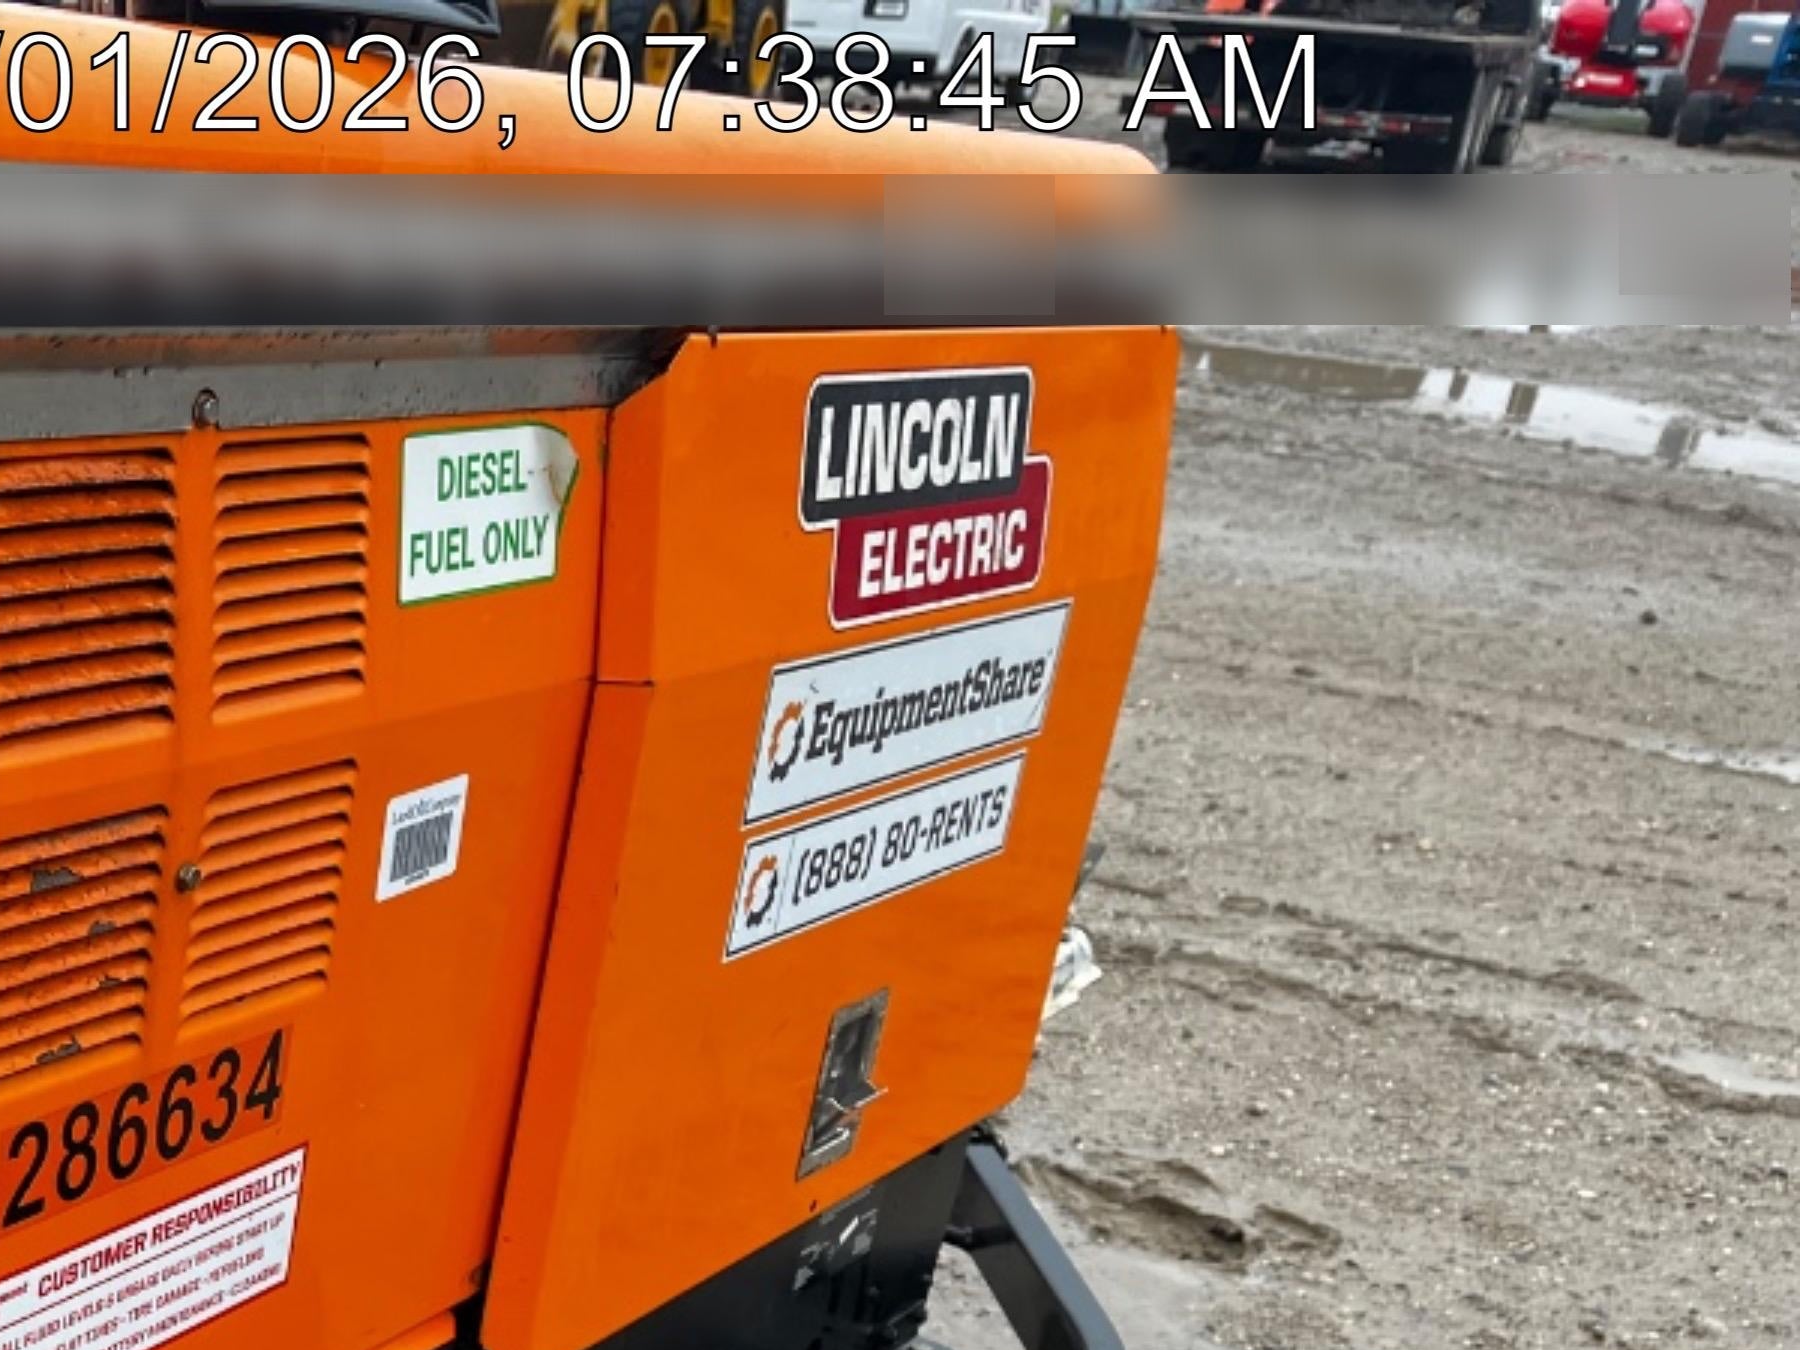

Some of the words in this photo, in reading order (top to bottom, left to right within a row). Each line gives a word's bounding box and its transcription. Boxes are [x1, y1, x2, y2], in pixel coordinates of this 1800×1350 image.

[437, 450, 527, 501] DIESEL
[815, 394, 1021, 502] LINCOLN
[410, 526, 474, 577] FUEL
[483, 513, 550, 564] ONLY
[858, 508, 1028, 600] ELECTRIC
[804, 655, 1045, 767] EquipmentShare
[792, 828, 876, 903] (888)
[881, 785, 1007, 873] 80-RENTS
[3, 1029, 284, 1227] 286634
[38, 1232, 149, 1298] CUSTOMER
[151, 1161, 301, 1246] RESPONSIBILITY
